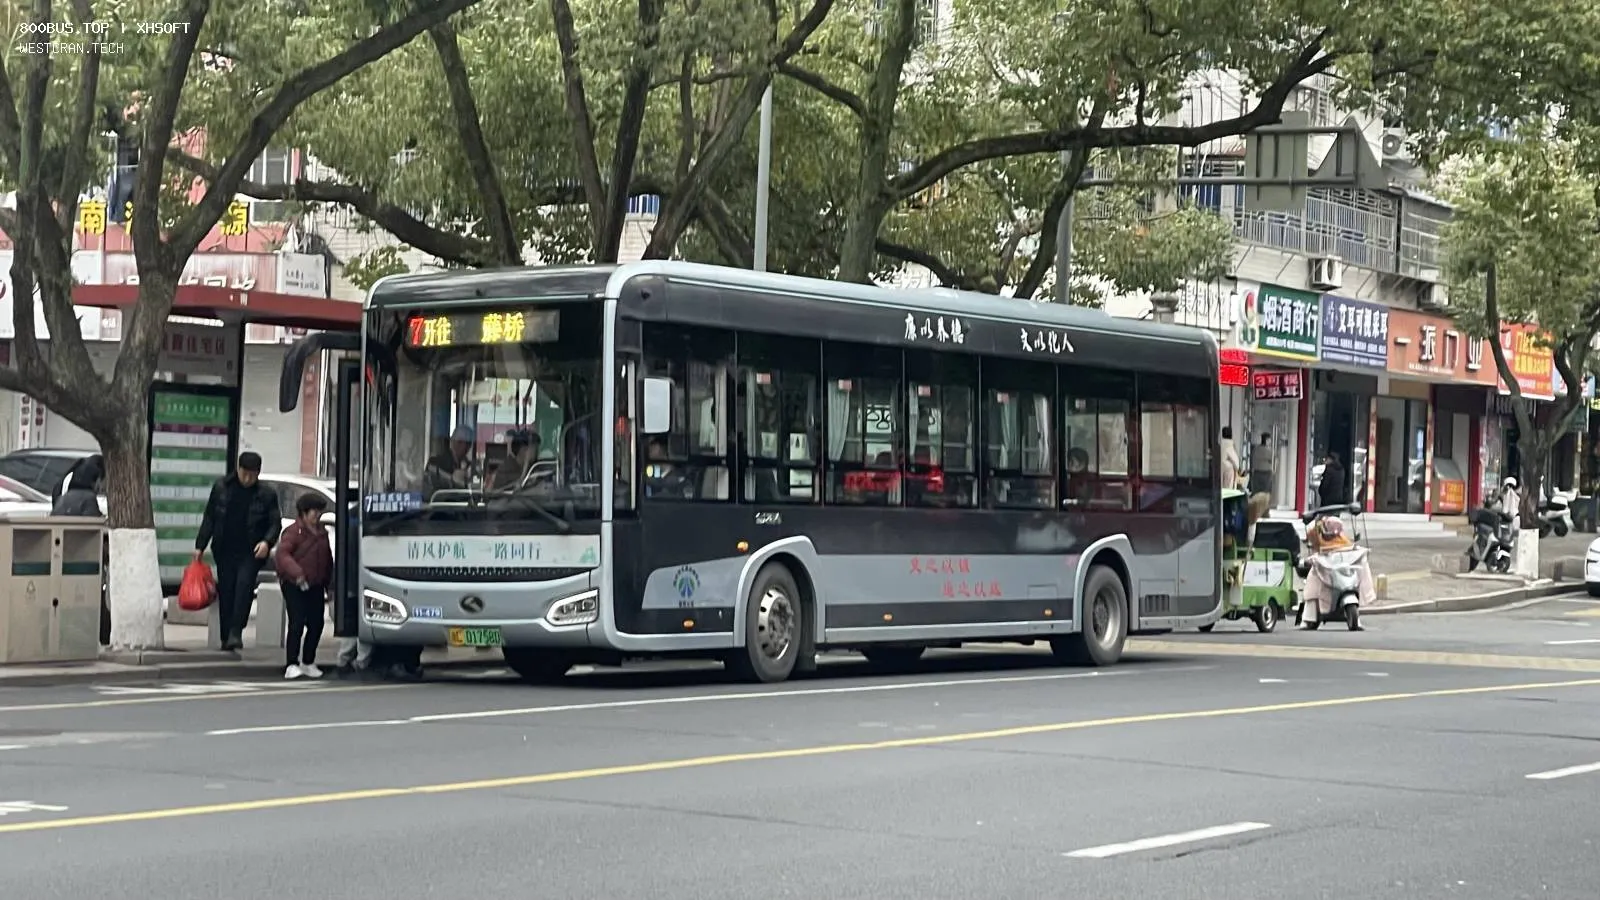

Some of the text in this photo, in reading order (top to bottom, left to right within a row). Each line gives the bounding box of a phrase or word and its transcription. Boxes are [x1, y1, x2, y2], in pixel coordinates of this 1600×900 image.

[481, 312, 525, 342] 藤桥
[1263, 294, 1318, 338] 烟酒商行
[1020, 328, 1074, 353] 文以化人
[407, 541, 542, 560] 清风护航 一路同行
